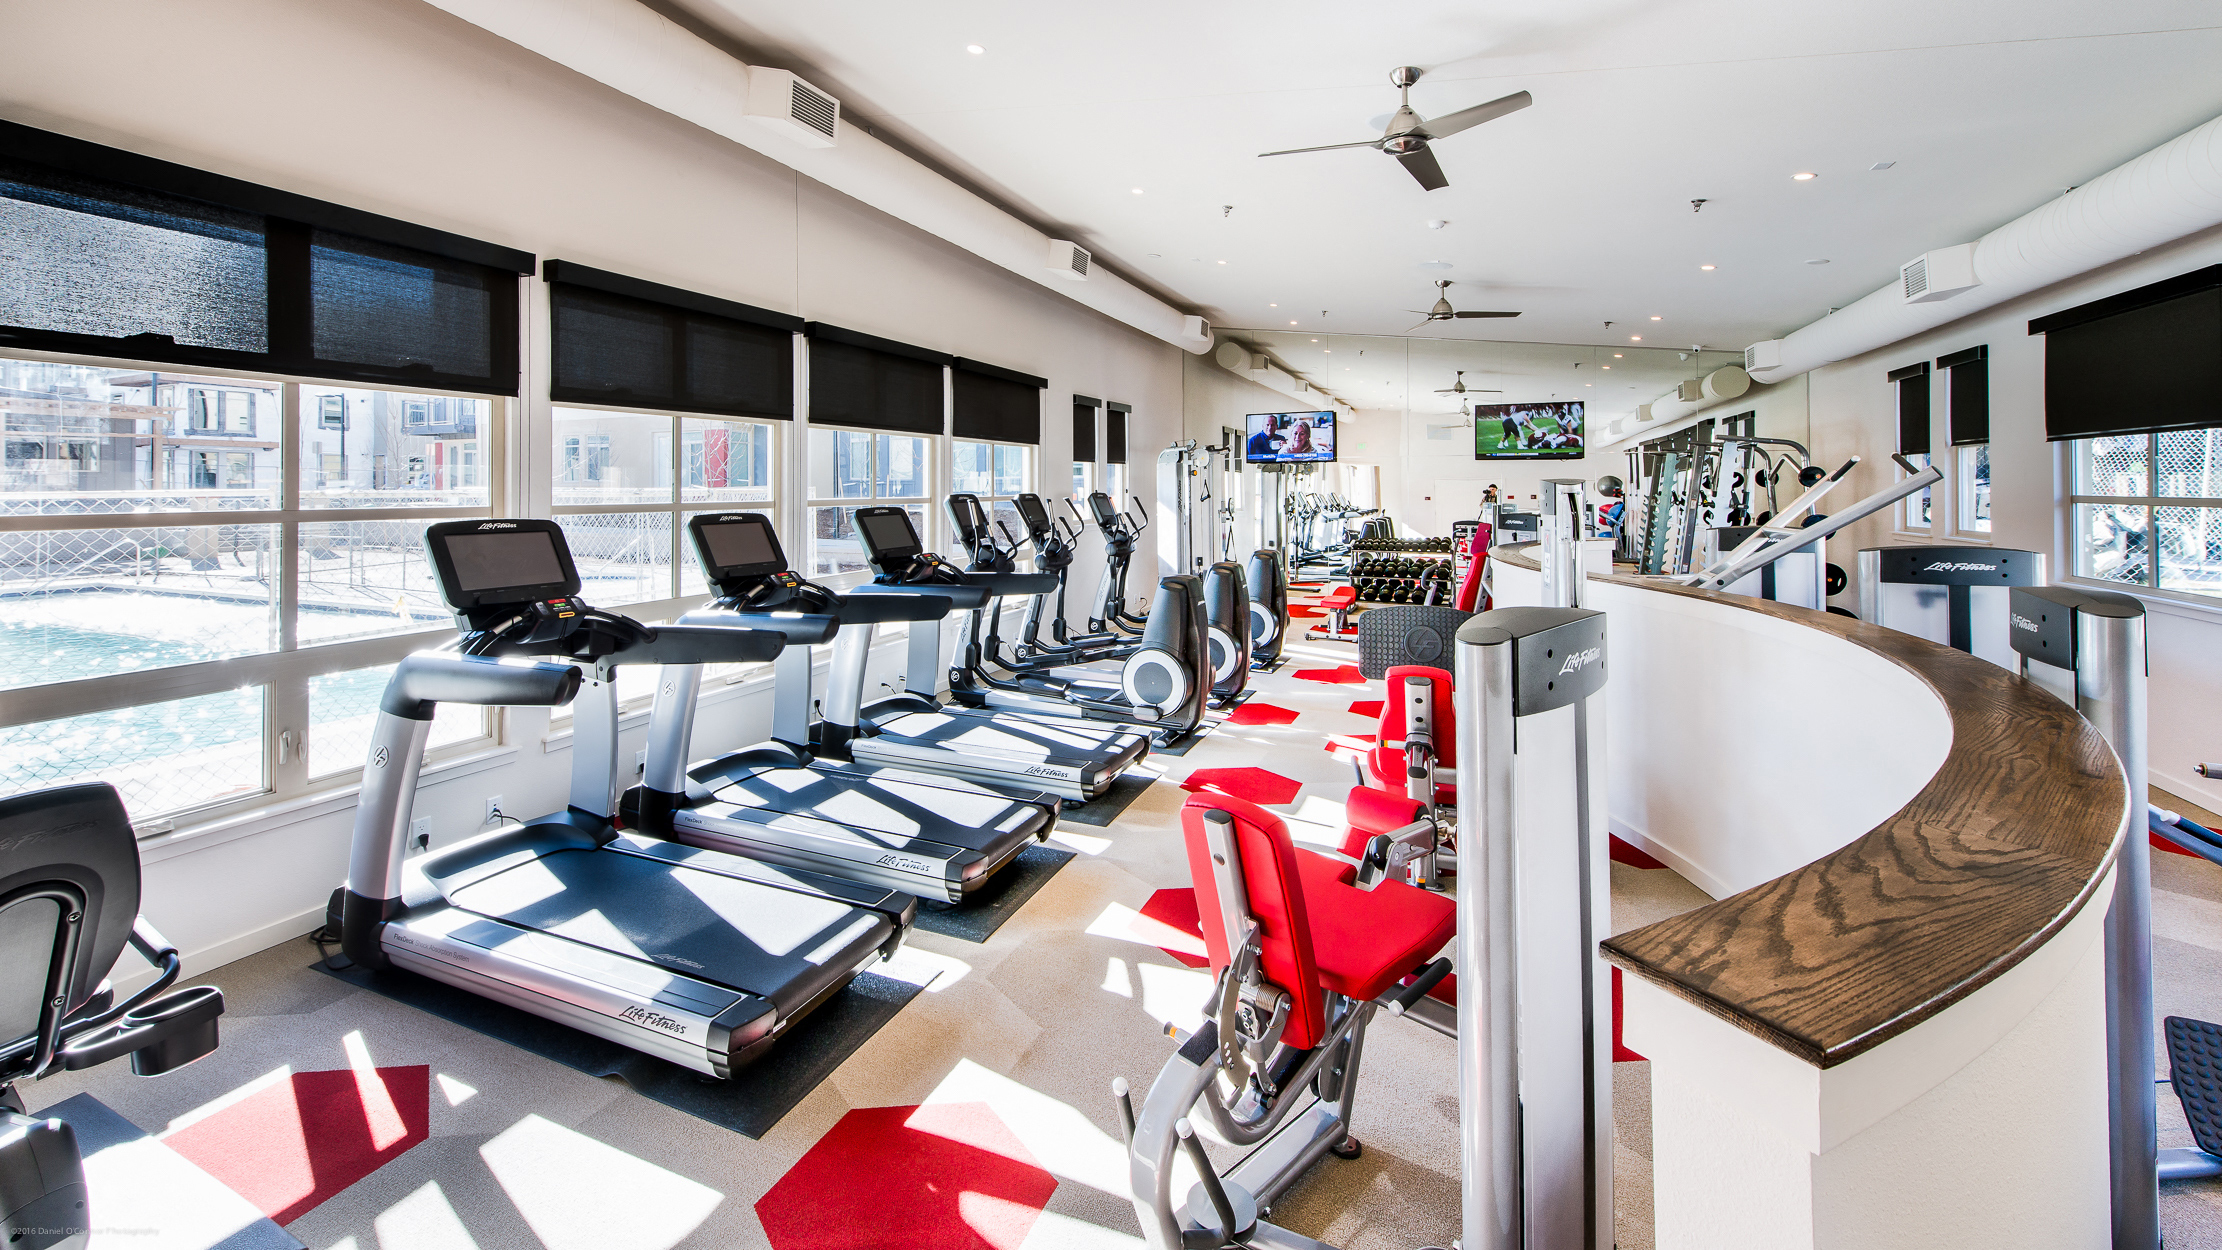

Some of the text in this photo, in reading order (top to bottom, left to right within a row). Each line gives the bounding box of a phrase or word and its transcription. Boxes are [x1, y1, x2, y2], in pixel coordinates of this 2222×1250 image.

[393, 932, 414, 945] FlexDeck
[428, 944, 453, 959] Absorption
[452, 951, 470, 963] System
